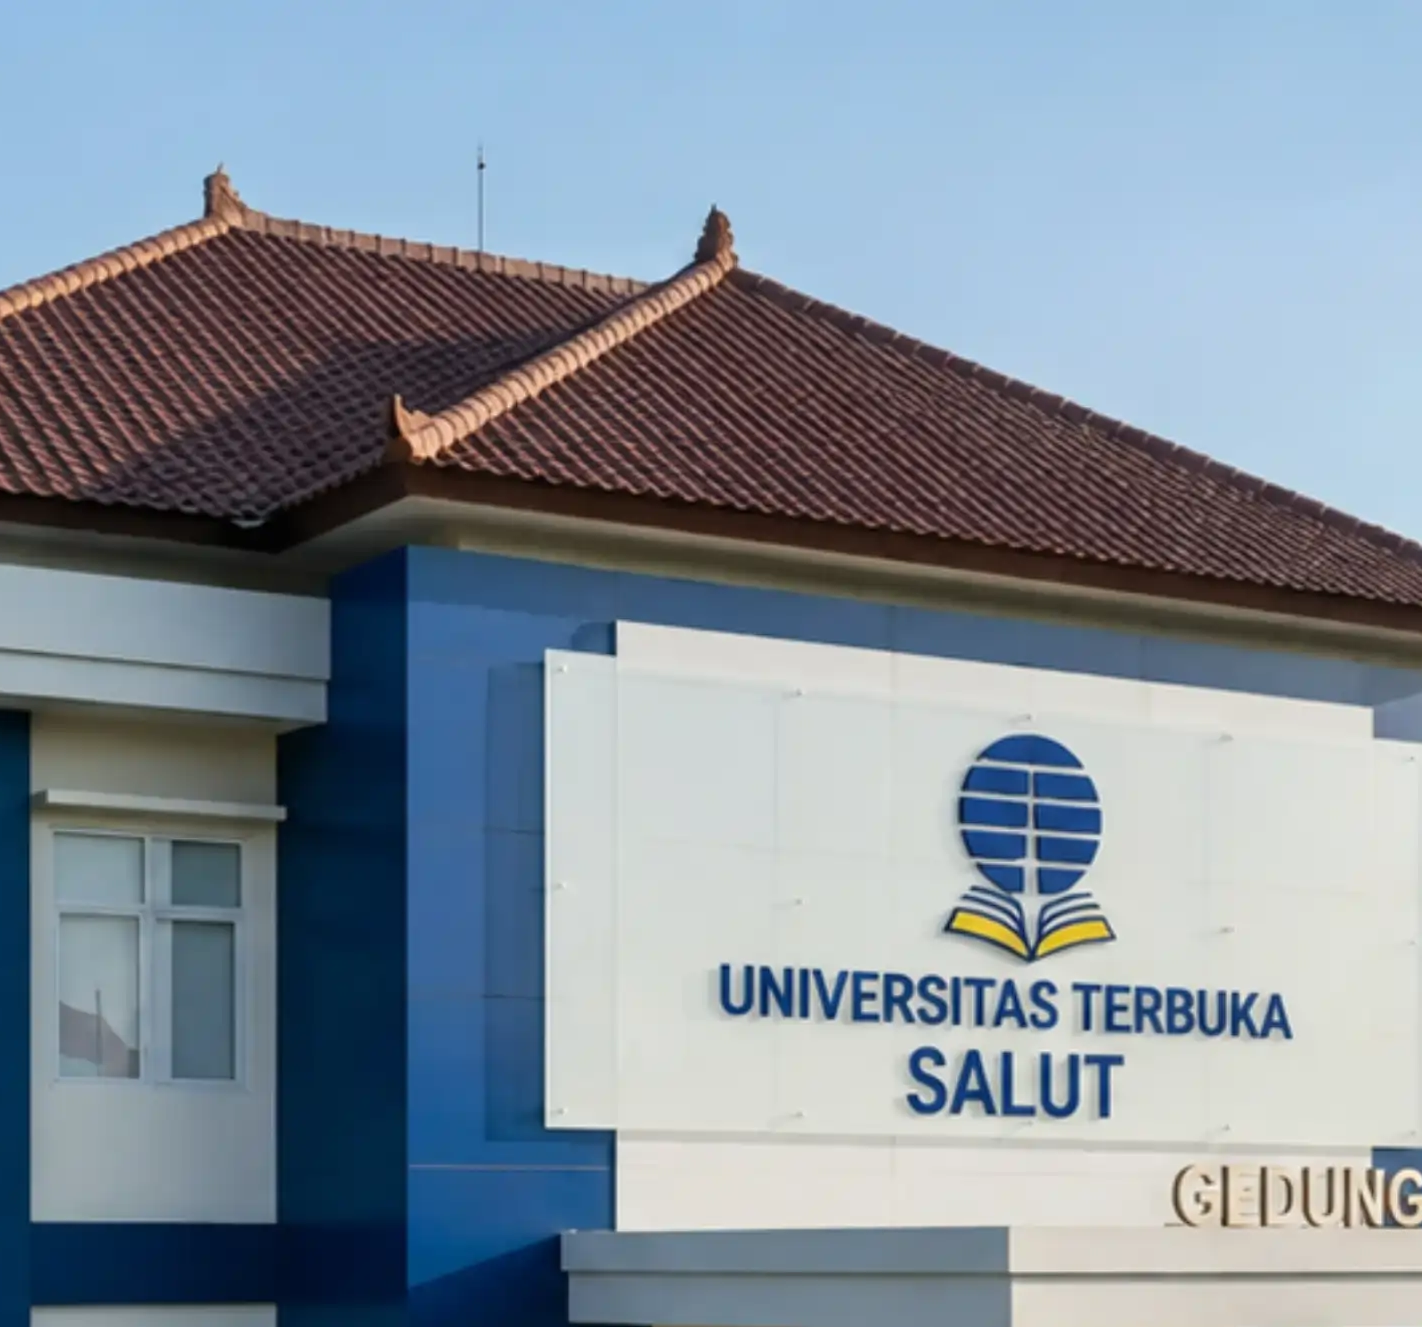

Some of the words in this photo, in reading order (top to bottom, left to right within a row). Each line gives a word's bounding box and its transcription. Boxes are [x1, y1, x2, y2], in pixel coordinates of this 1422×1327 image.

[718, 962, 1059, 1030] UNIVERSITAS
[1071, 982, 1293, 1039] TERBUKA
[906, 1046, 1125, 1119] SALUT
